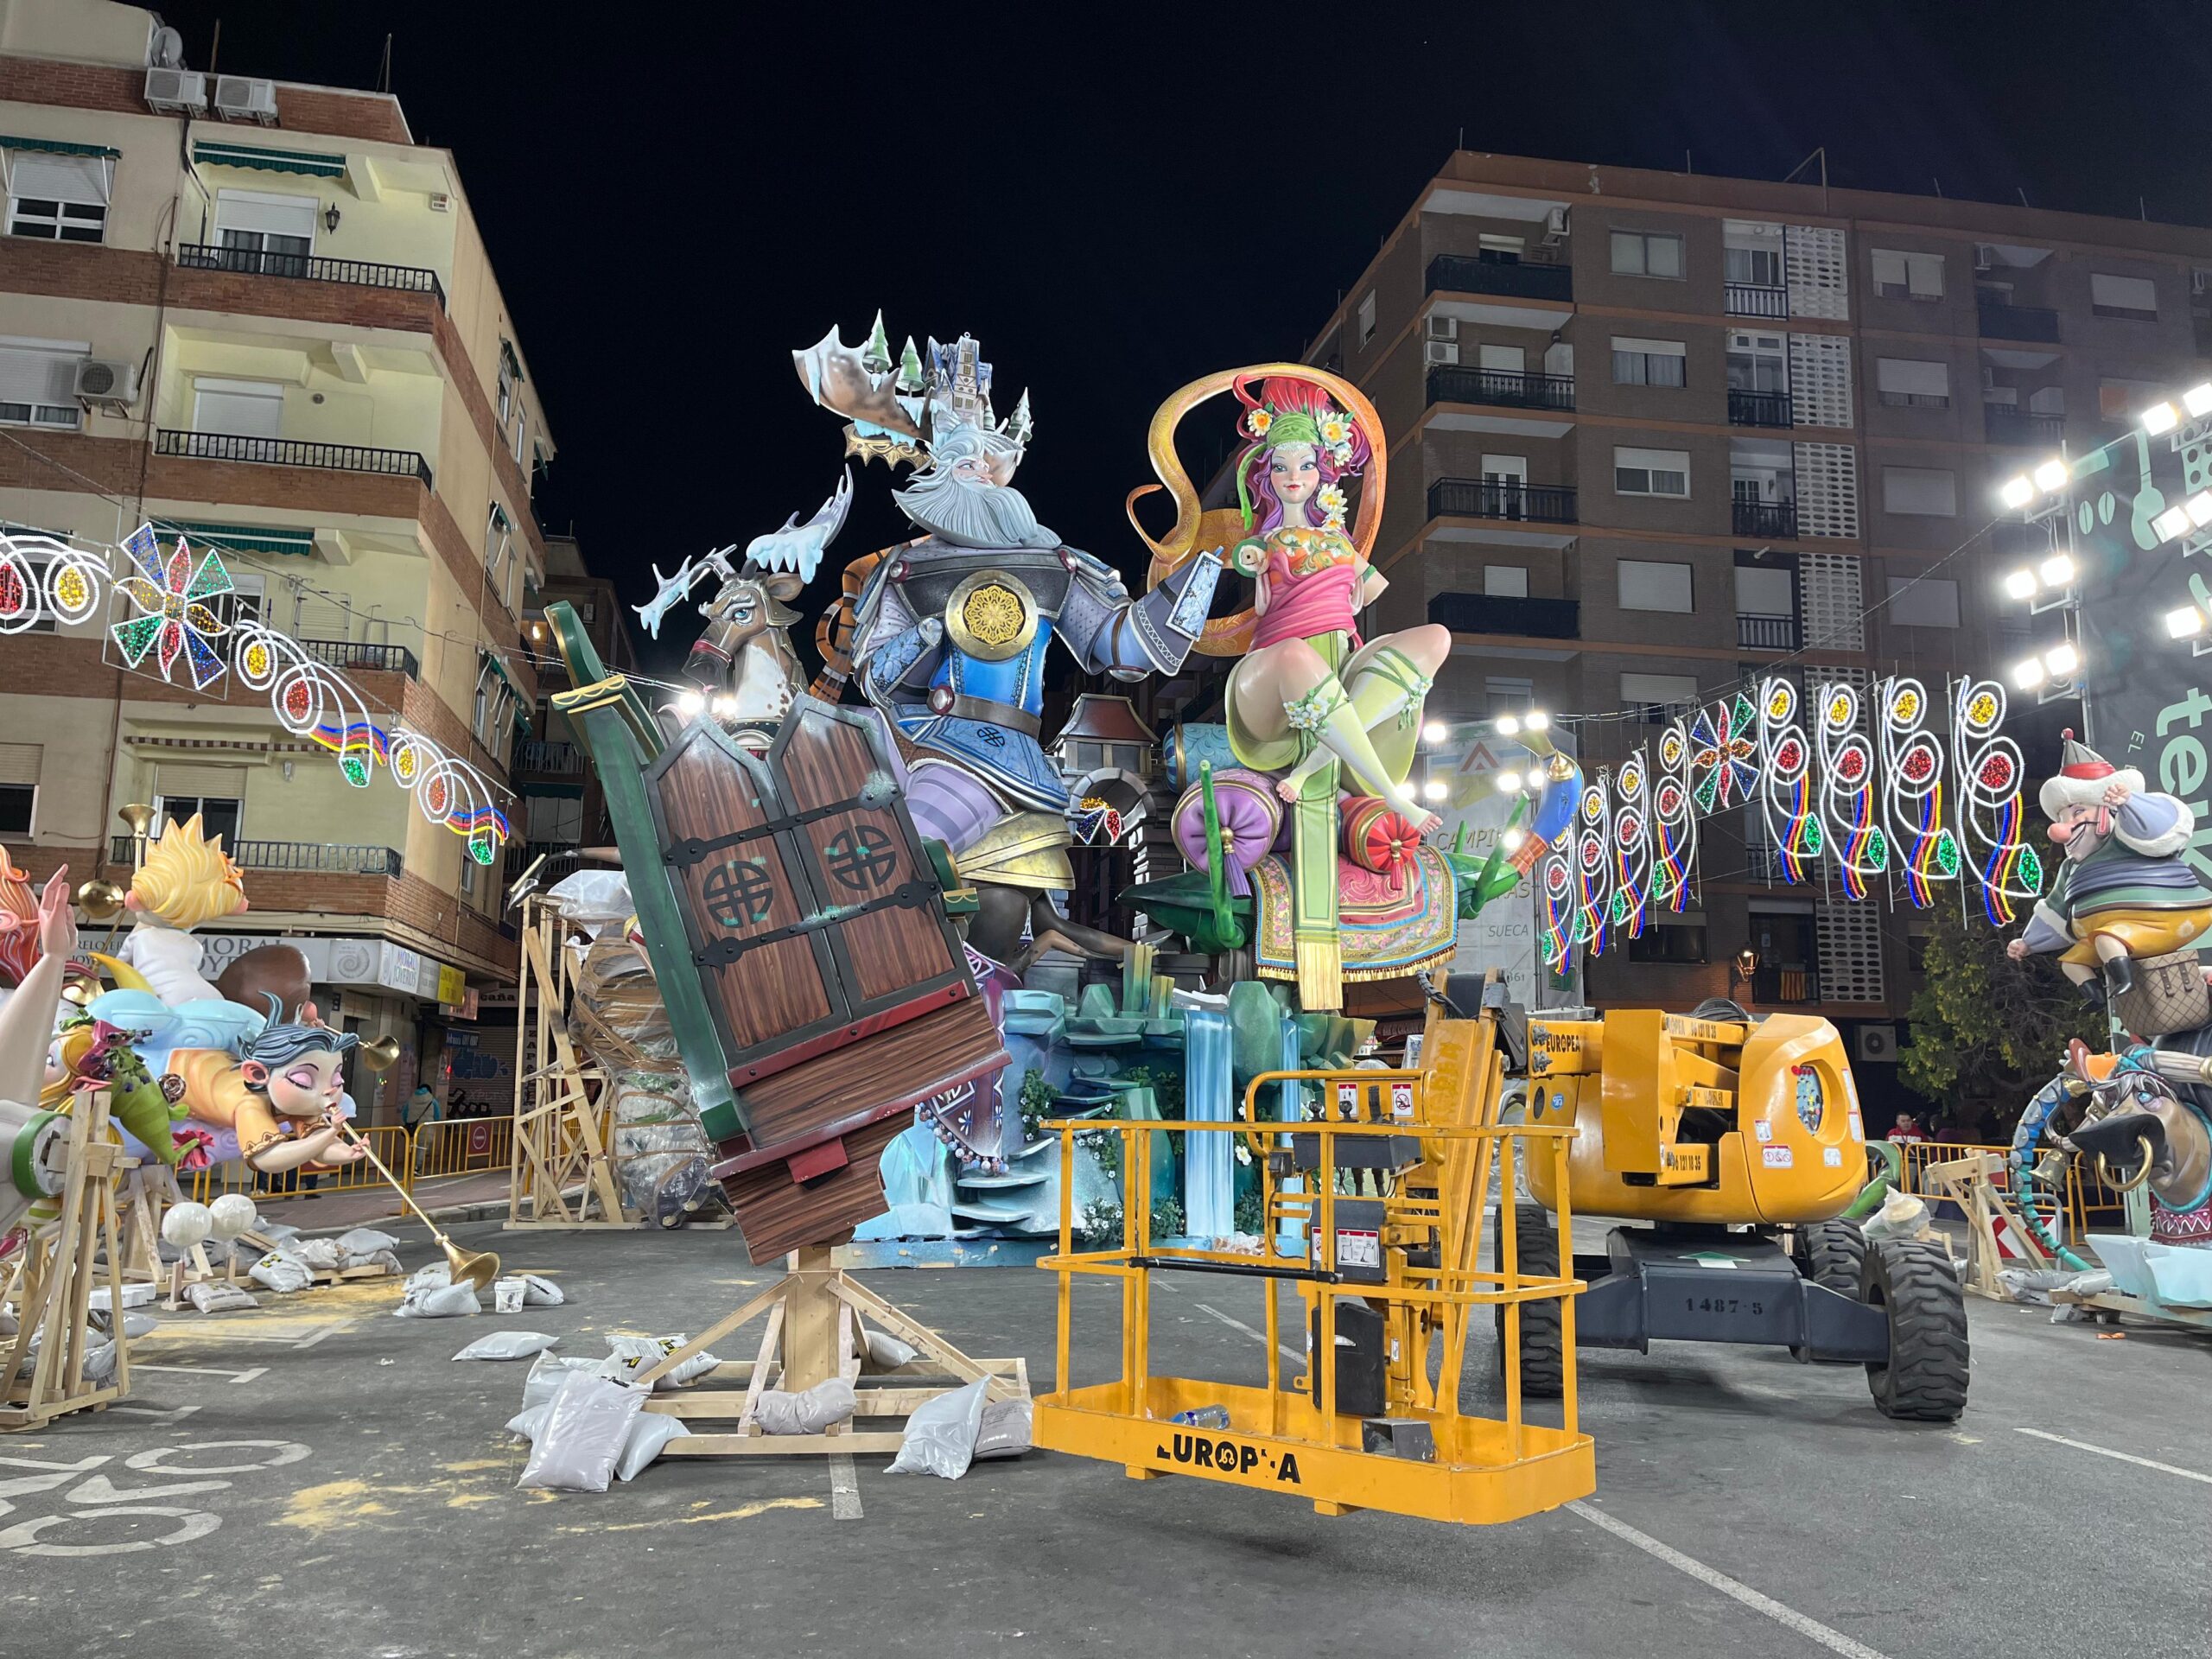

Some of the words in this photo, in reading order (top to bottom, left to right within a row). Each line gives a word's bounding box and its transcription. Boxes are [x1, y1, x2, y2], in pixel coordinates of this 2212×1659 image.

[1488, 925, 1529, 938] SUECA
[1547, 1033, 1580, 1052] EUROPEA
[1694, 1155, 1701, 1171] 35
